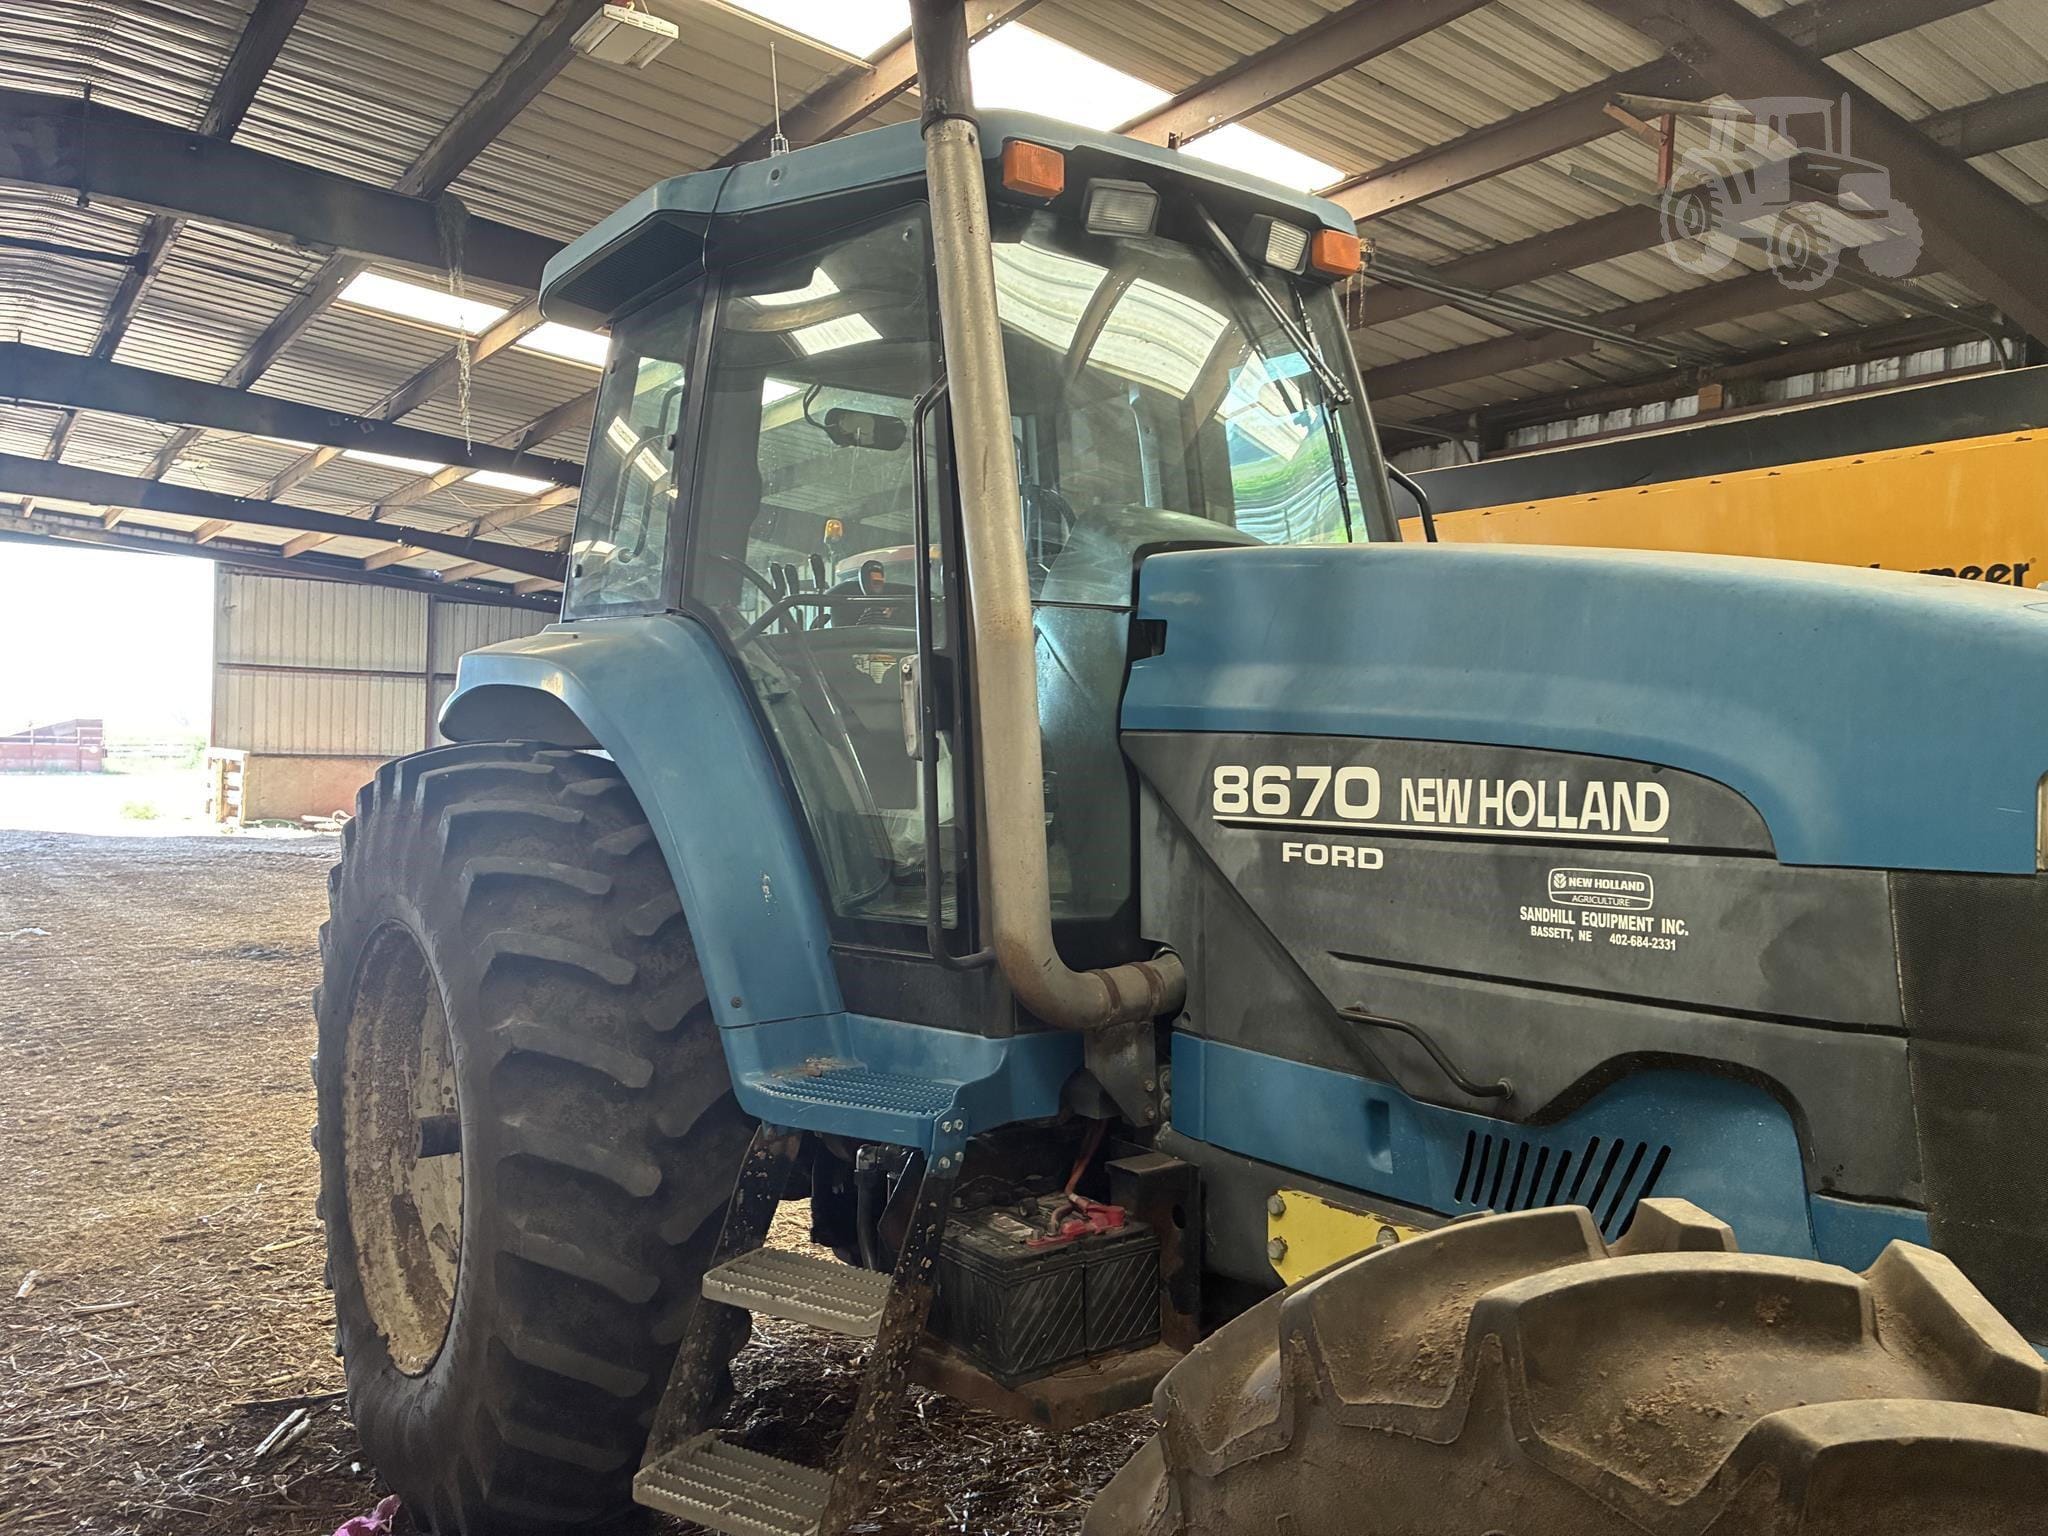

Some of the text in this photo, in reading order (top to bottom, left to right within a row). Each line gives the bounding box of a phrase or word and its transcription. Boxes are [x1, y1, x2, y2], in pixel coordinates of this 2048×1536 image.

[1213, 765, 1670, 833] 8670 NEW HOLLAND
[1282, 842, 1384, 870] FORD
[1568, 877, 1645, 892] NEW HOLLAND
[1571, 895, 1631, 907] AGRICULTURE
[1520, 906, 1689, 936] SANDHILL EQUIPMENT INC.
[1530, 925, 1677, 951] BASSETT, NE 402-684-2331
